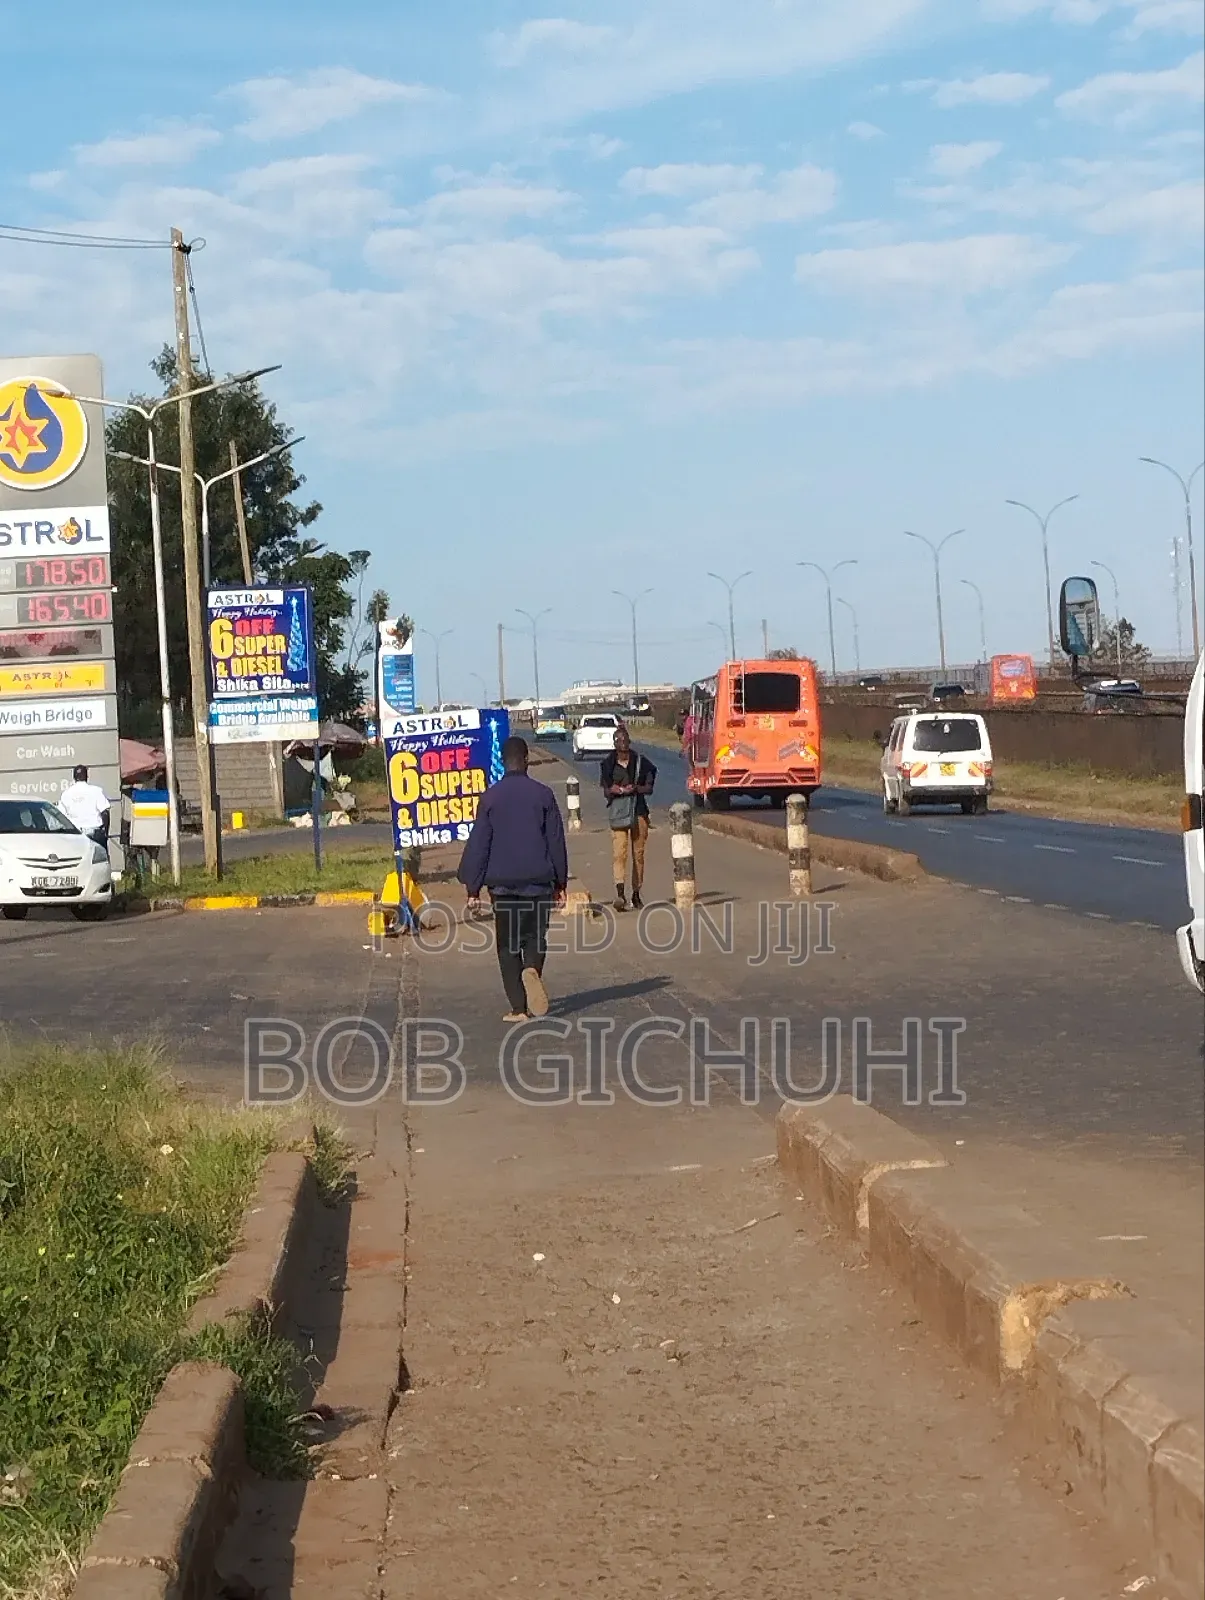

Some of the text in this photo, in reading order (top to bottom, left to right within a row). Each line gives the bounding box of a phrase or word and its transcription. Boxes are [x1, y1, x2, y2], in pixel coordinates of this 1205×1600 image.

[214, 592, 274, 606] ASTROL
[235, 618, 275, 636] OFF
[210, 618, 234, 660] 6
[234, 634, 287, 656] SUPER
[215, 655, 284, 678] & DIESEL
[216, 677, 259, 692] Shika
[45, 706, 93, 723] Bridge
[392, 714, 469, 736] ASTROL
[16, 744, 76, 760] Car Wash
[388, 737, 429, 753] Happy
[420, 747, 470, 774] OFF
[10, 780, 58, 795] Service
[389, 751, 420, 805] 6
[420, 768, 487, 800] SUPER
[397, 807, 413, 830] &
[399, 827, 452, 849] Shika
